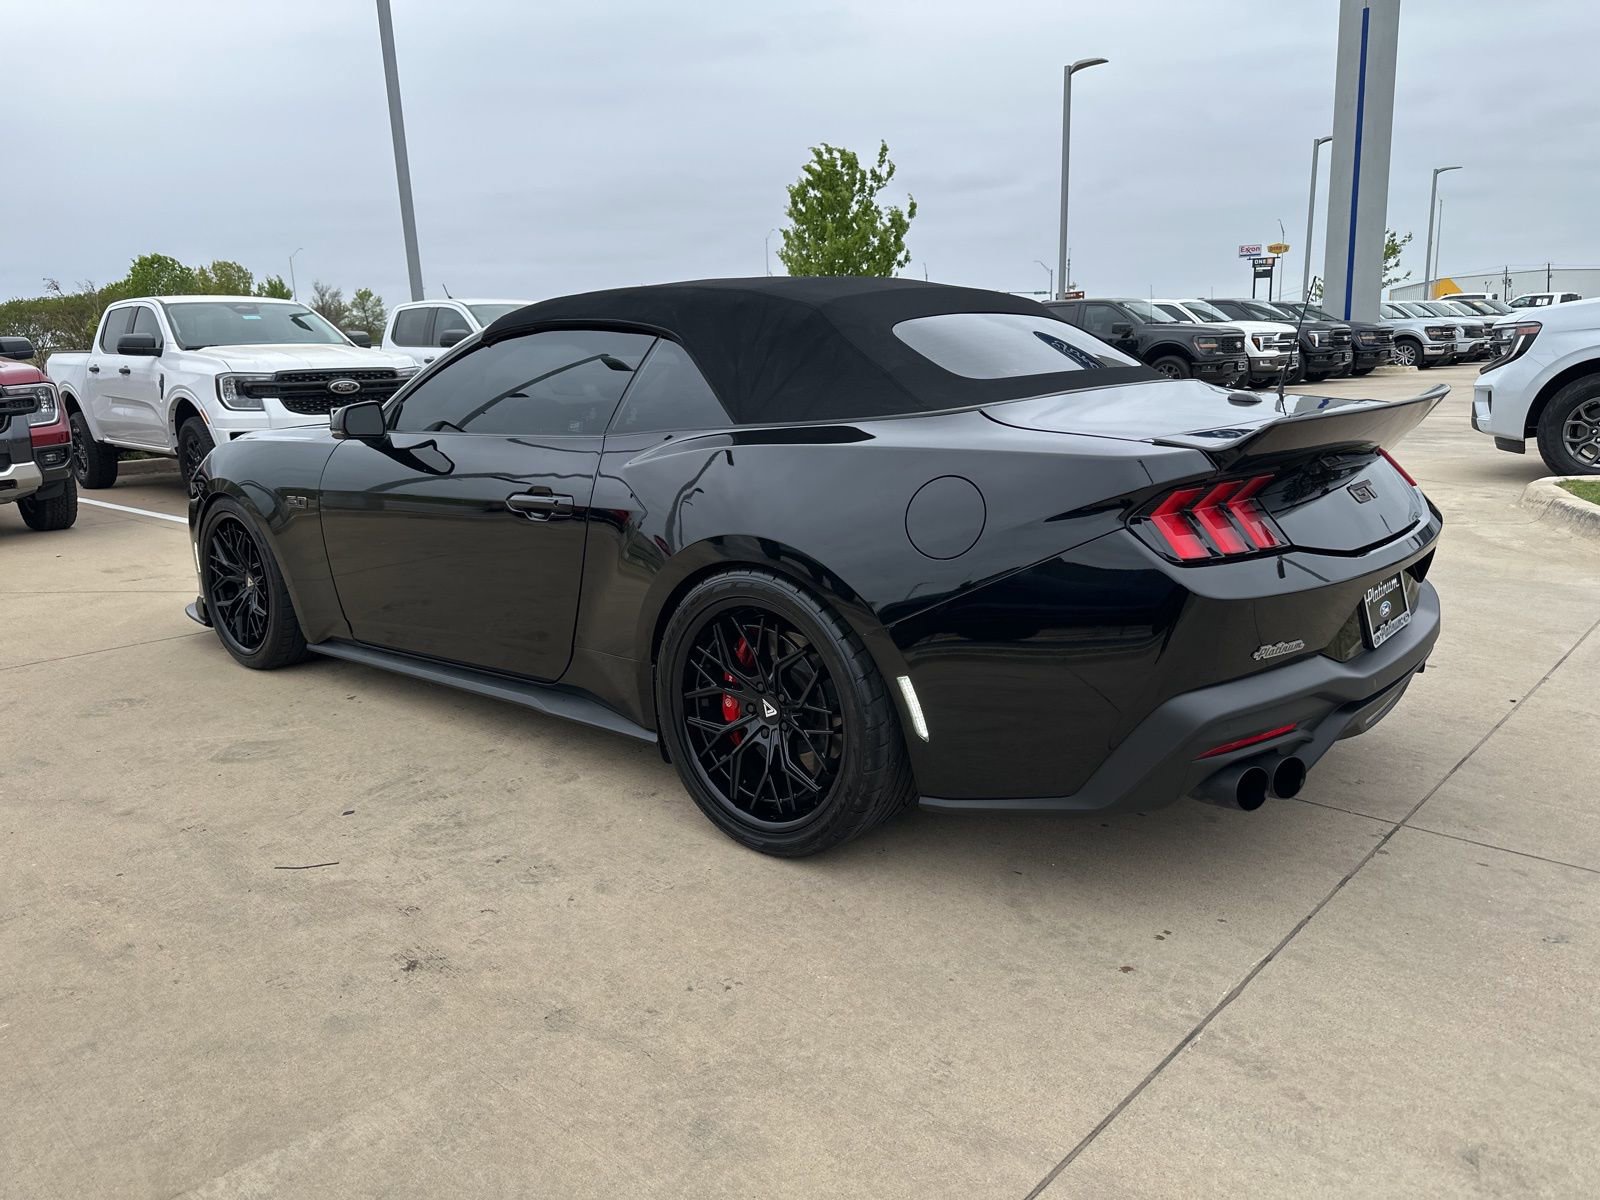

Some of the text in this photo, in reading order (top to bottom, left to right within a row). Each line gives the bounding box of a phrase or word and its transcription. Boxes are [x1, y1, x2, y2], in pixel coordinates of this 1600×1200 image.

[1346, 479, 1378, 504] GT
[1365, 577, 1400, 606] Platinum
[1252, 639, 1305, 660] Platinum
